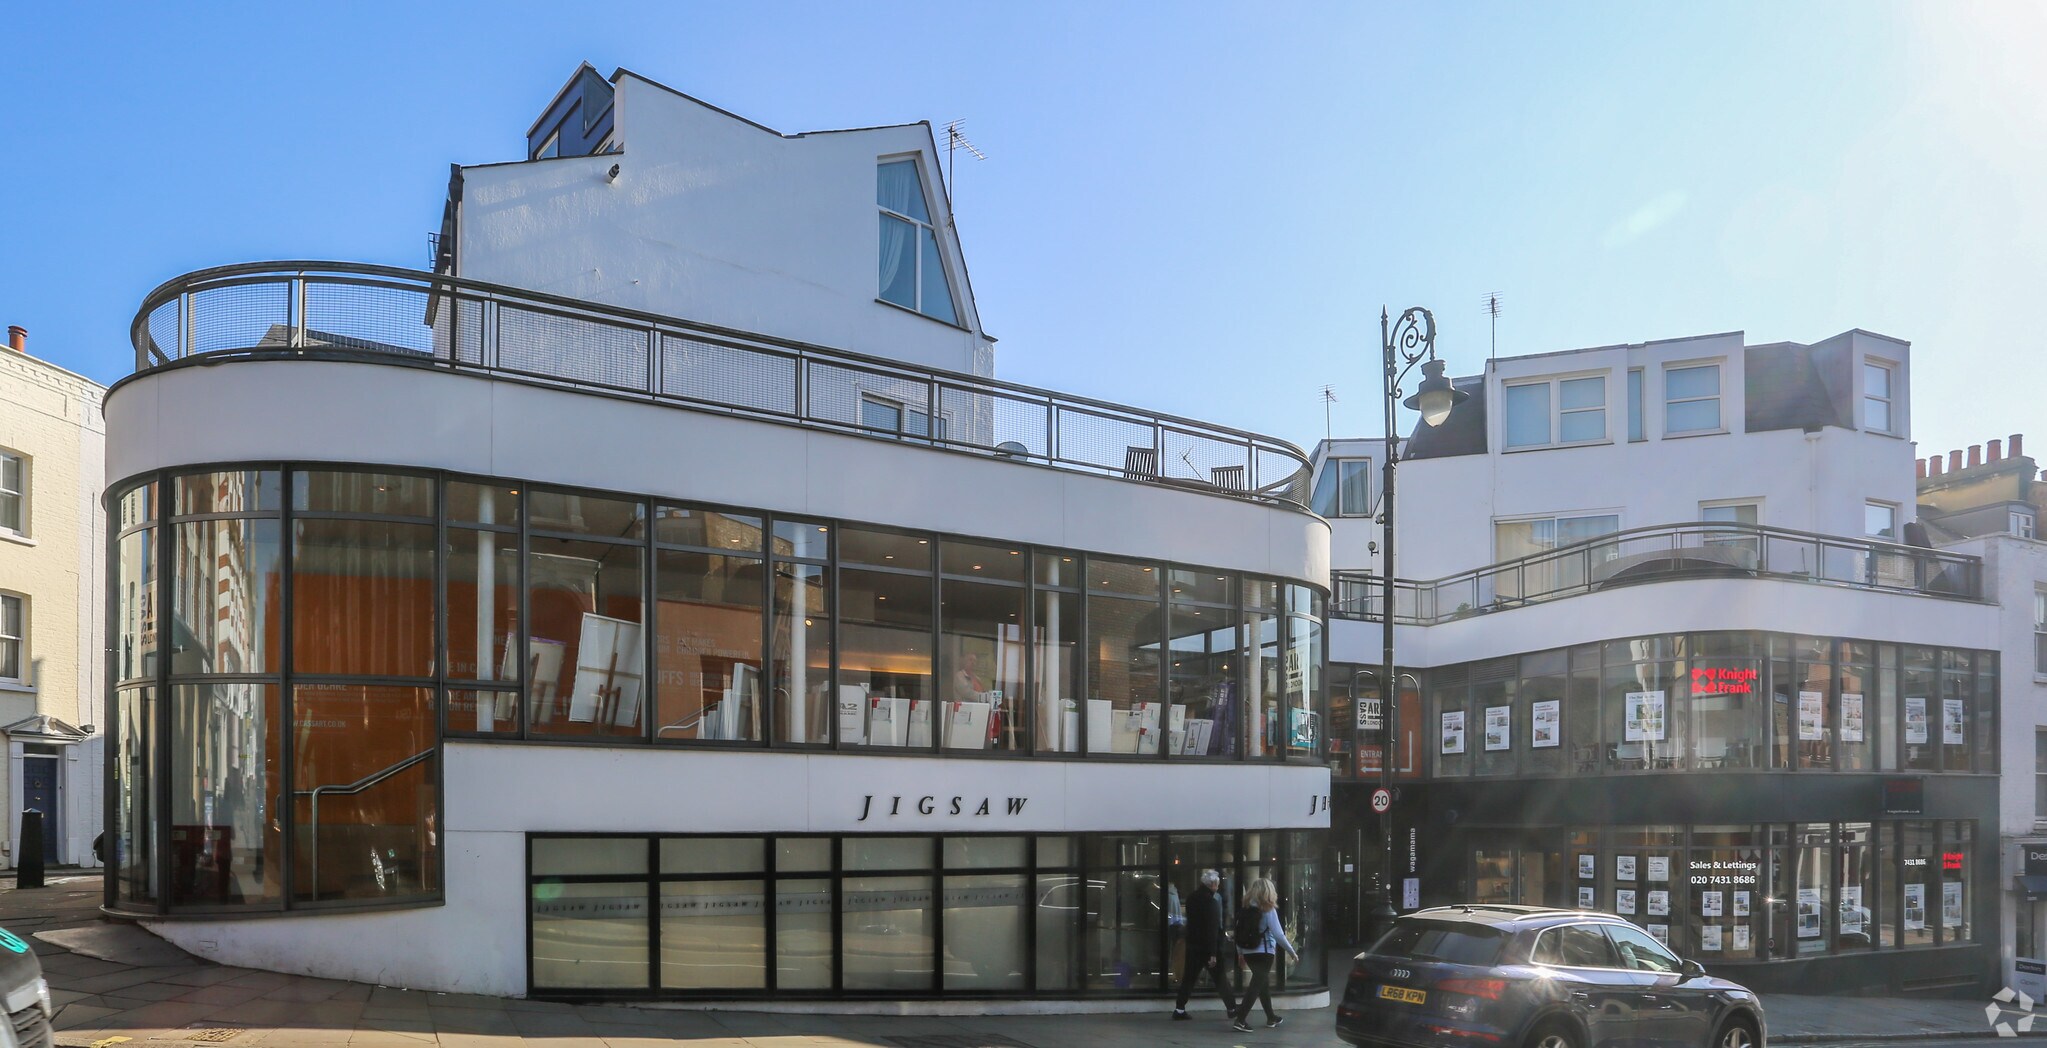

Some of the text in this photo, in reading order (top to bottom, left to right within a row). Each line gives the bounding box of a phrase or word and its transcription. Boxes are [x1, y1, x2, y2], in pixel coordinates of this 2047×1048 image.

[1718, 668, 1758, 682] Knight
[1718, 682, 1752, 694] Frank
[1359, 702, 1368, 725] CASS
[1360, 750, 1382, 758] ENTRAN
[1374, 795, 1388, 806] 20
[858, 795, 1028, 821] JIGSAW
[1690, 861, 1756, 870] Sales & Lettings
[1690, 876, 1756, 884] 020 7431 8686
[594, 903, 641, 912] JIGSAW
[660, 902, 698, 910] IGSAW
[1381, 986, 1425, 1002] LR68 KPN
